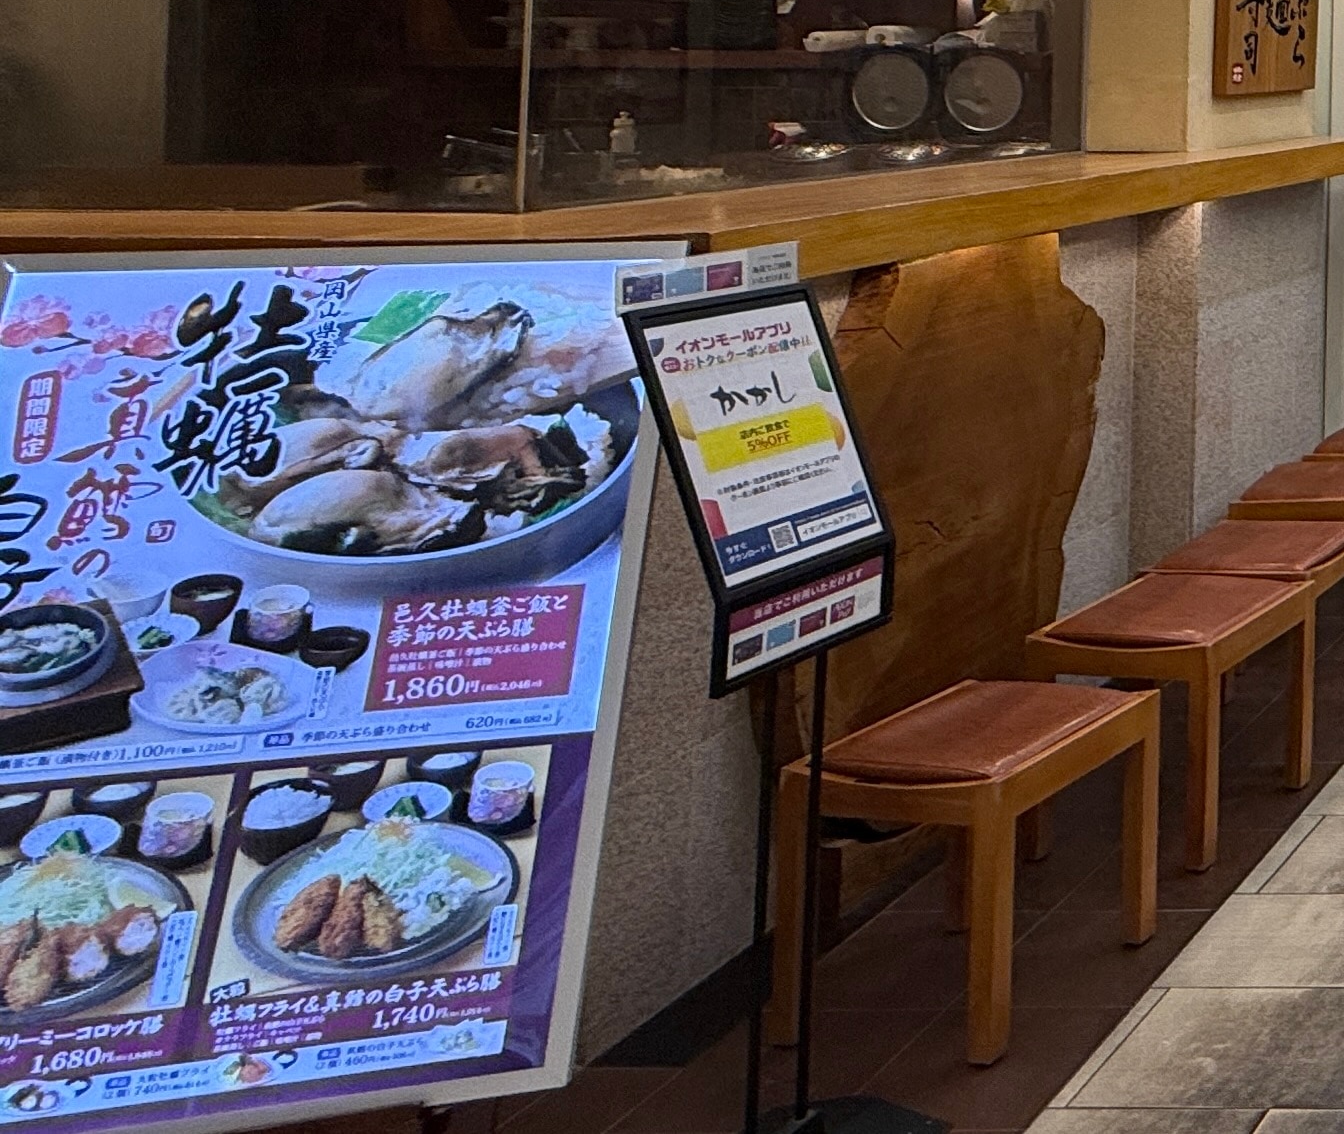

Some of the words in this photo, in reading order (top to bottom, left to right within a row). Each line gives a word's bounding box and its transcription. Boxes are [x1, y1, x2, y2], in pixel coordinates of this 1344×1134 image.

[306, 281, 345, 362] 岡山県産
[675, 322, 792, 354] イオンモールアプリ
[152, 280, 310, 497] 牡蠣
[710, 370, 797, 416] かかし
[20, 377, 54, 459] 期間限定
[747, 432, 793, 451] 5%OFF
[382, 674, 480, 703] 1,860円
[302, 722, 430, 743] 季節の天ぷら盛り合わせ
[465, 716, 504, 730] 620円
[372, 1004, 448, 1031] 1,740円
[30, 1047, 113, 1075] 1,680円
